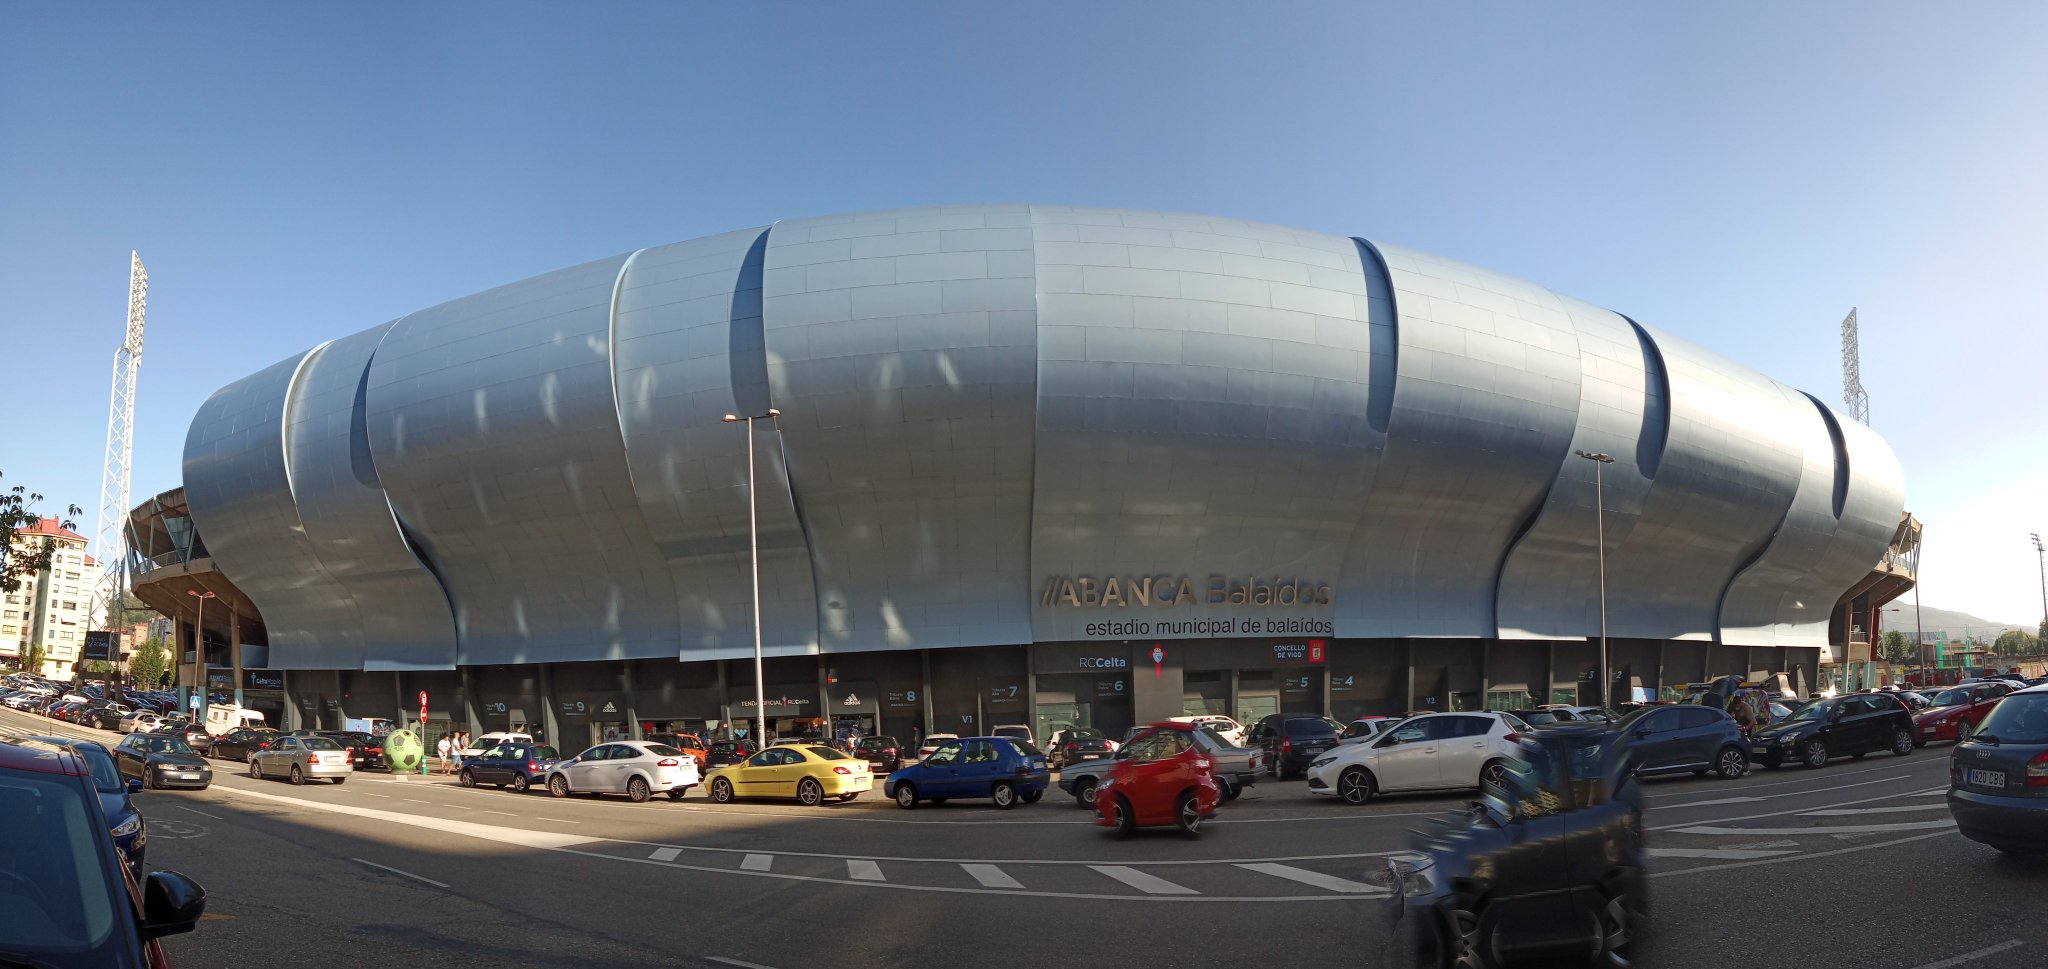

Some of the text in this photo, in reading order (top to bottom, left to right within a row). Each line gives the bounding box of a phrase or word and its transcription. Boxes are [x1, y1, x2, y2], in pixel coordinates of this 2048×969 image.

[1086, 617, 1332, 637] estadio municipal de balaídos
[1079, 657, 1126, 668] RCCelta
[1114, 680, 1124, 691] 6
[1300, 677, 1309, 688] 5
[1345, 675, 1354, 686] 4
[906, 691, 916, 702] 8
[1008, 686, 1018, 697] 7
[494, 702, 506, 712] 10
[576, 701, 585, 712] 9
